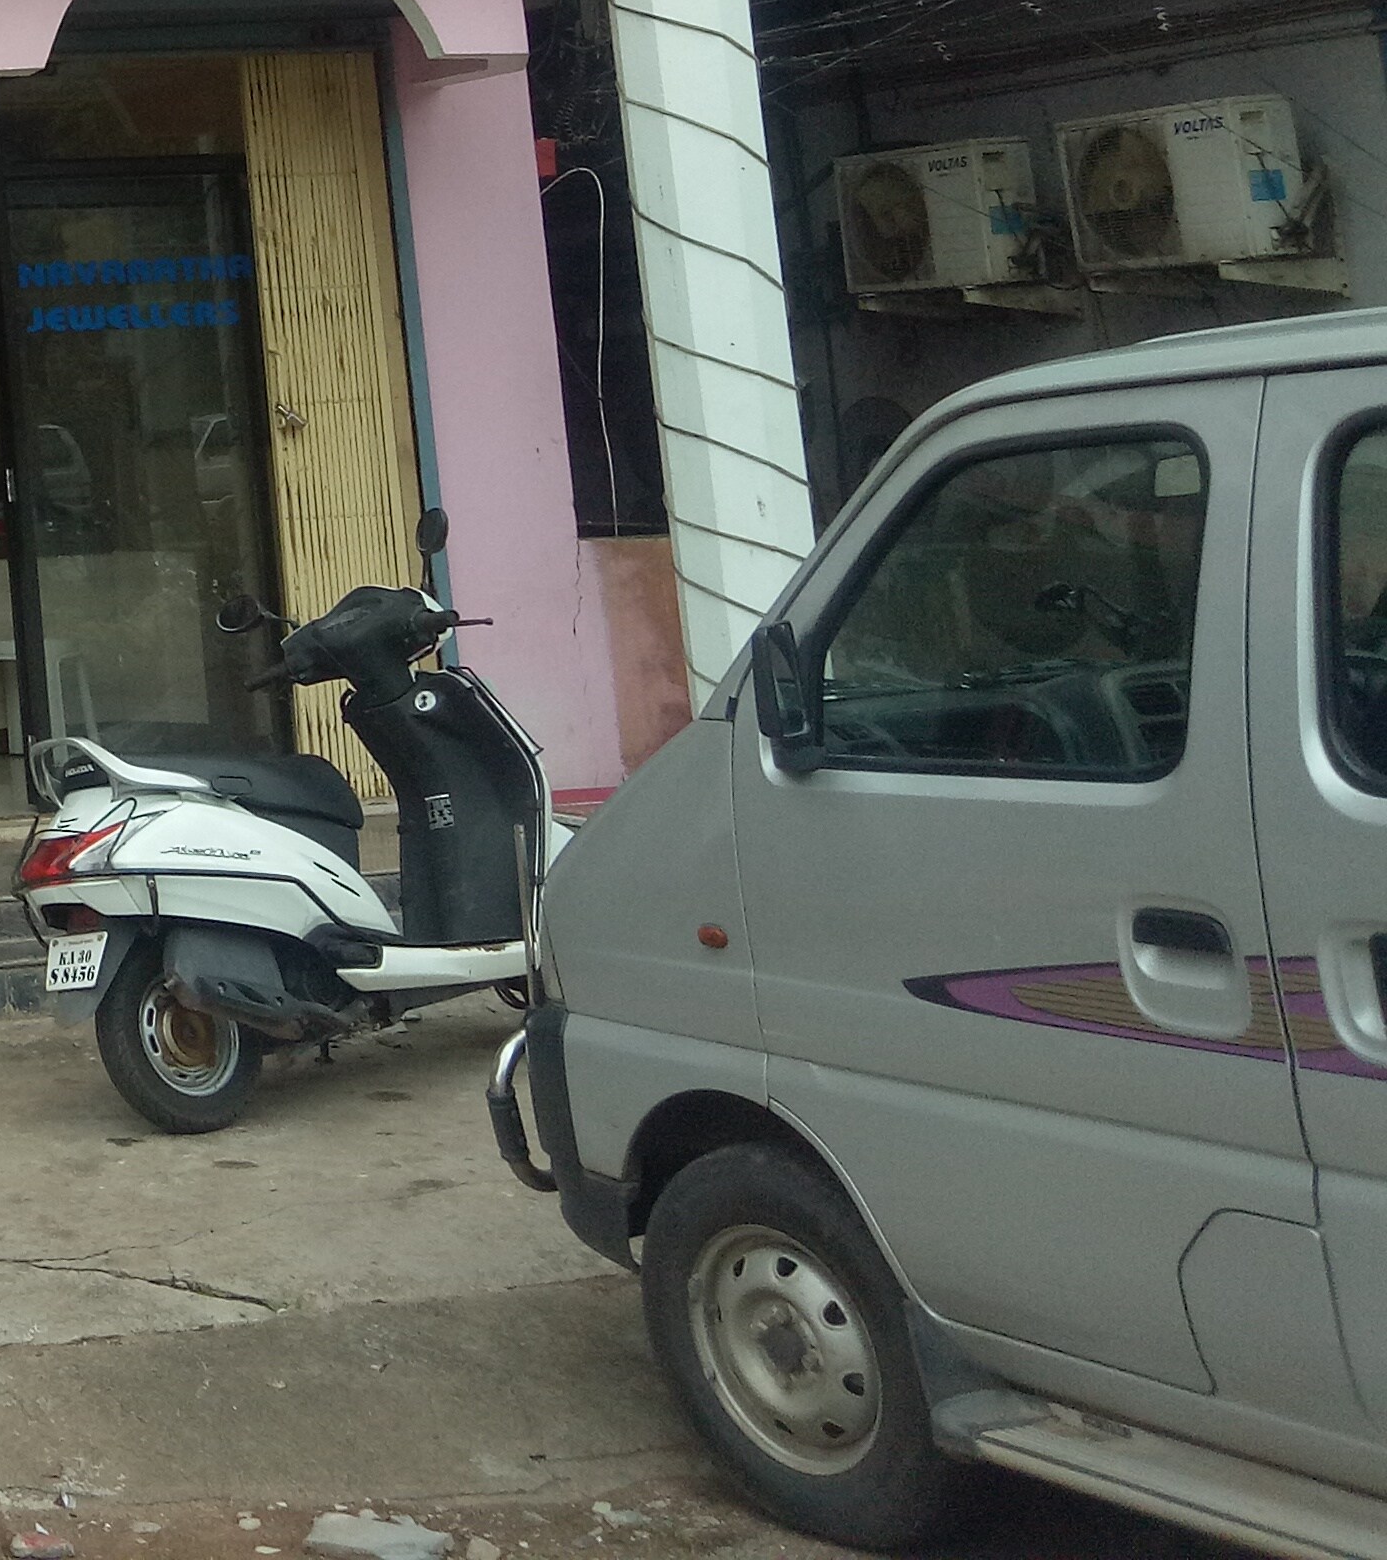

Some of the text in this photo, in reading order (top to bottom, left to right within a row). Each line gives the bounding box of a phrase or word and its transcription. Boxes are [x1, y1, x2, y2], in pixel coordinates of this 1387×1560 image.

[1173, 115, 1224, 135] VOLTAS
[928, 155, 968, 172] VOLTAS
[27, 298, 240, 333] JEWELLERS
[58, 949, 92, 966] KA 30
